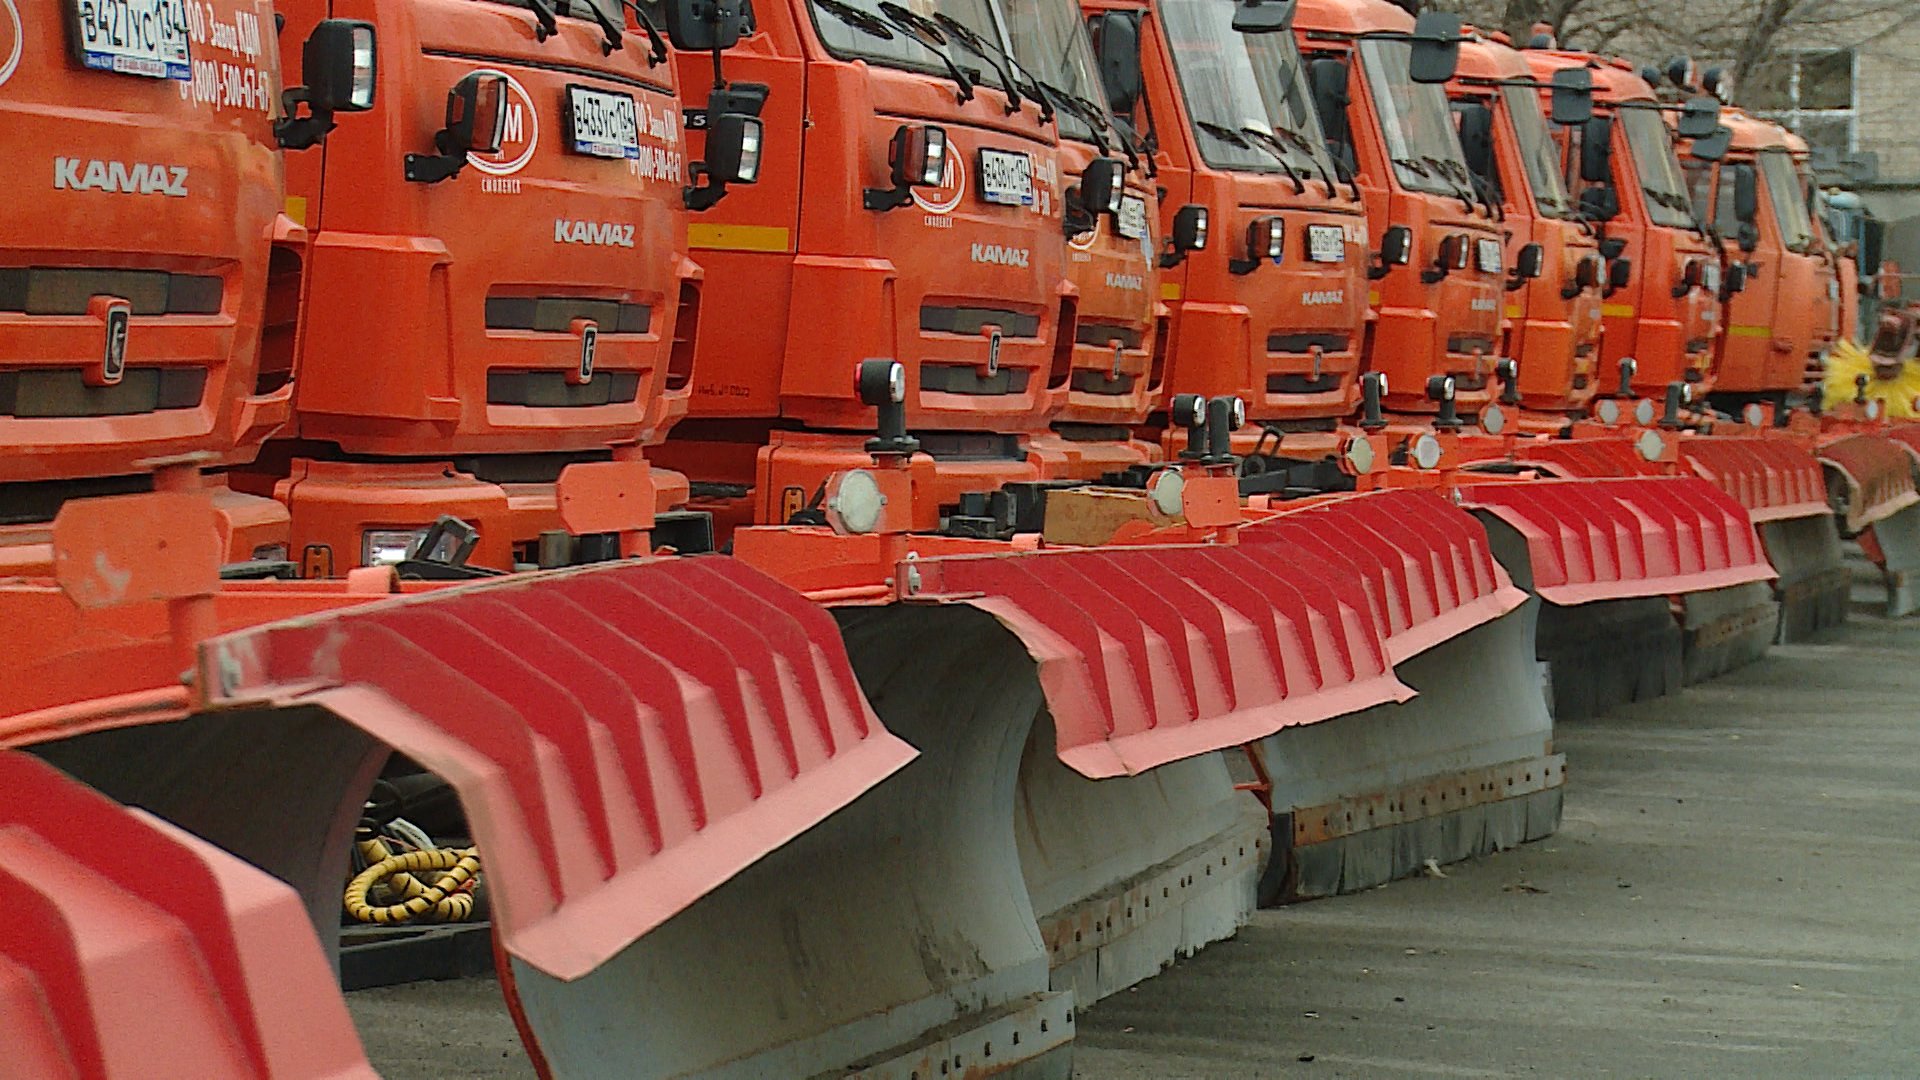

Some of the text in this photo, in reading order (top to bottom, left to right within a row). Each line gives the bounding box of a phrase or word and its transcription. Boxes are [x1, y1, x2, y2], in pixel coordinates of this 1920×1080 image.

[54, 156, 188, 197] KAMAZ
[554, 218, 635, 247] KAMAZ
[971, 243, 1030, 268] KAMAZ
[1106, 272, 1142, 291] KAMAZ
[1302, 289, 1344, 306] KAMAZ
